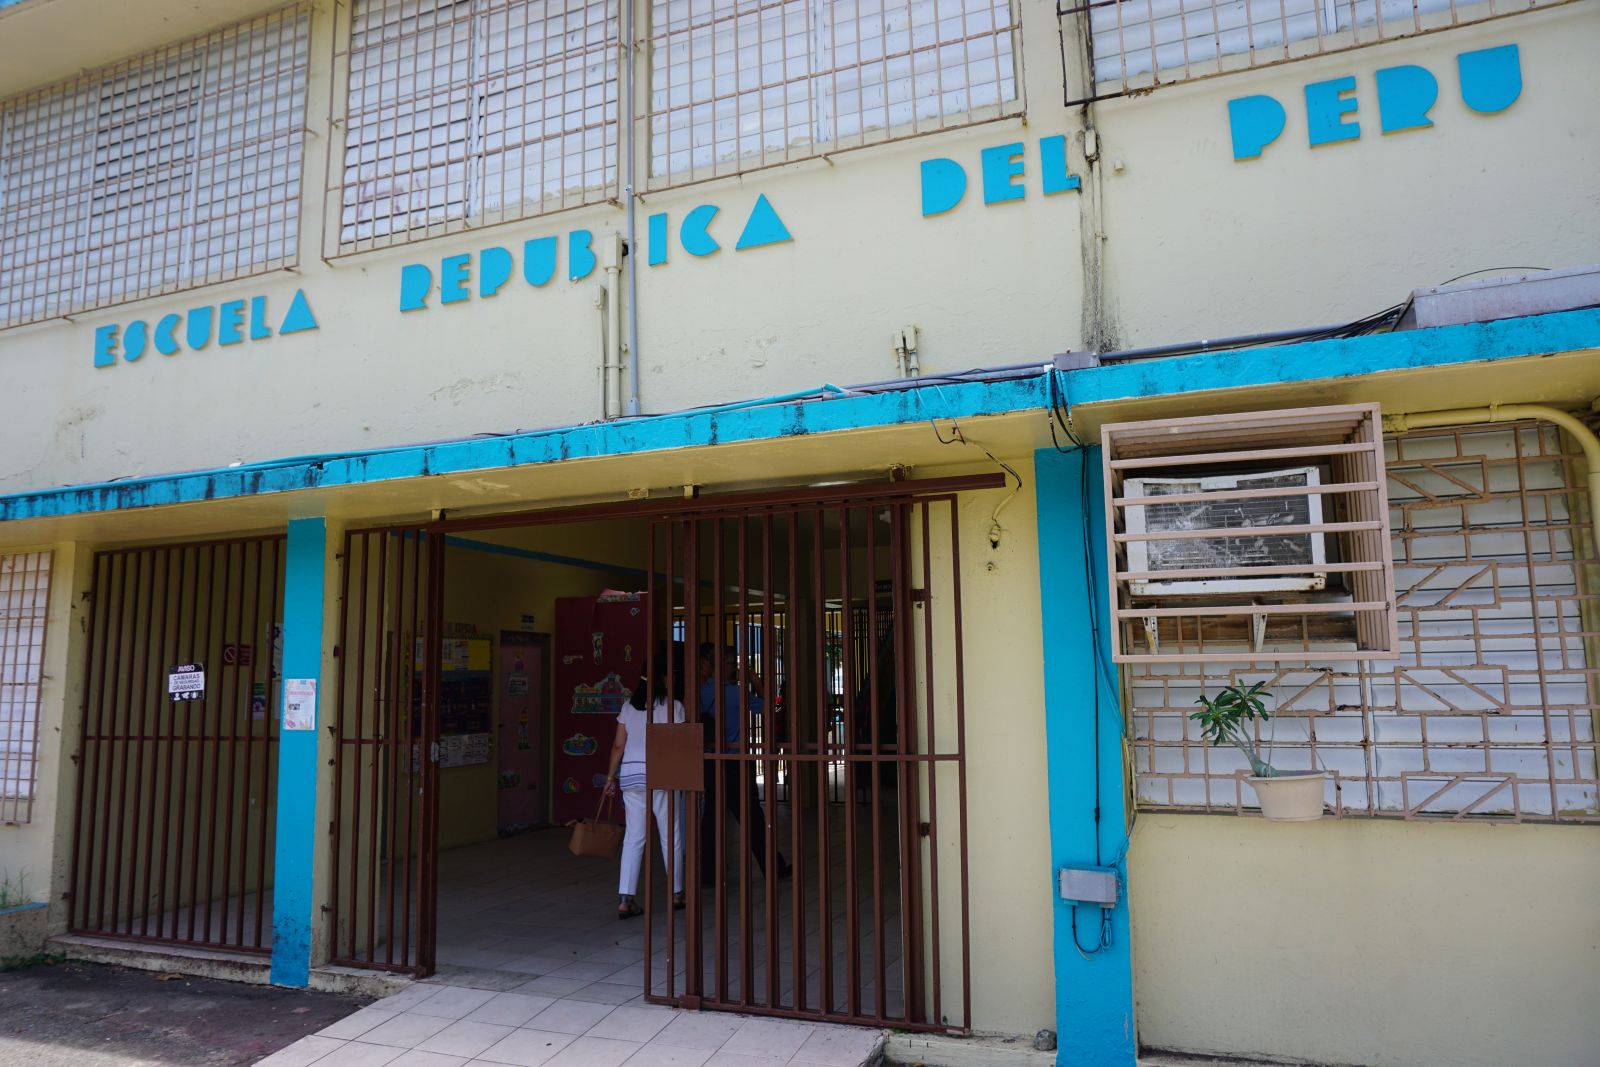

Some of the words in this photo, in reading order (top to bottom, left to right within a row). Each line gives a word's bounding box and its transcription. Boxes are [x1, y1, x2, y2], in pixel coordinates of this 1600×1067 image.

[94, 289, 317, 368] ESCUELA
[399, 192, 793, 312] REPUBICA
[920, 134, 1081, 216] DEL
[1227, 43, 1523, 161] PERU
[177, 664, 195, 672] AVISO
[172, 683, 201, 691] GRABANDO
